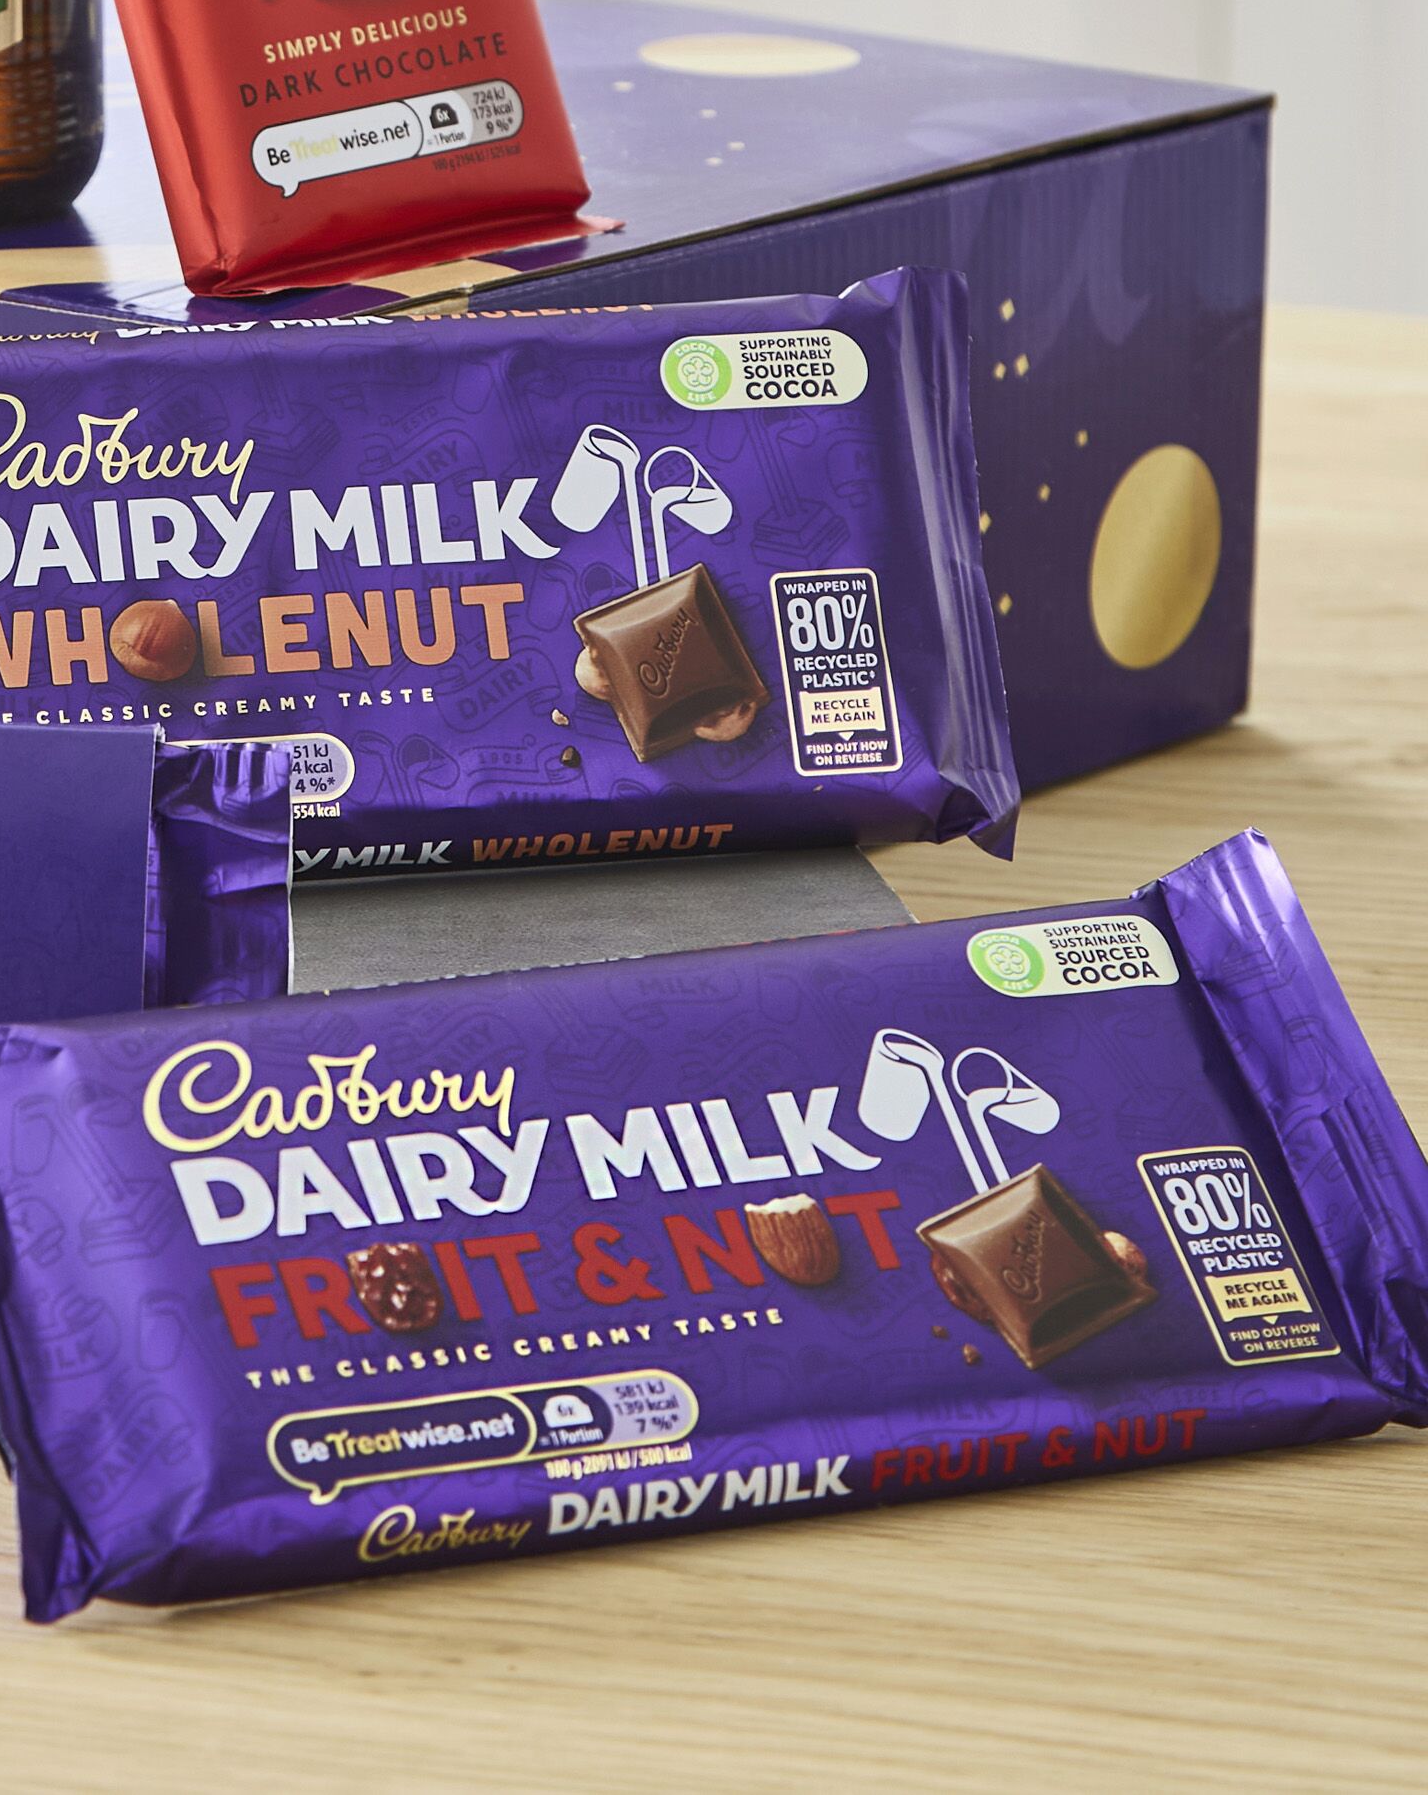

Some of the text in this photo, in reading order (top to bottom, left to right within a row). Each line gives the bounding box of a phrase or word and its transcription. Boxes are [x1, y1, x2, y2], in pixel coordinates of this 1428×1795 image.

[264, 6, 468, 64] SIMPLY DELICIOUS
[239, 32, 508, 108] DARK CHOCOLATE
[493, 100, 514, 115] kcal
[486, 121, 494, 134] 9
[674, 342, 716, 357] COCOA
[739, 337, 831, 350] SUPPORTING
[741, 349, 832, 363] SUSTAINABLY
[744, 363, 835, 379] SOURCED
[746, 379, 838, 400] COCOA
[289, 477, 561, 571] MILK
[784, 579, 867, 595] WRAPPED IN
[787, 593, 874, 652] 80%
[637, 608, 699, 700] Cadbury
[794, 653, 878, 671] RECYCLED
[36, 704, 173, 725] CLASSIC
[193, 695, 317, 716] CREAMY
[338, 687, 434, 707] TASTE
[814, 698, 870, 710] RECYCLE
[812, 711, 876, 724] ME AGAIN
[314, 743, 329, 758] kJ
[806, 740, 888, 754] FIND OUT HOW
[304, 759, 333, 774] kcal
[815, 752, 882, 766] ON REVERSE
[295, 779, 306, 793] 4
[317, 802, 340, 817] kcal
[331, 840, 453, 871] MILK
[471, 823, 734, 864] WHOLENUT
[1044, 922, 1138, 937] SUPPORTING
[1049, 933, 1141, 949] SUSTAINABLY
[1055, 946, 1149, 965] SOURCED
[1062, 961, 1159, 985] COCOA
[142, 1039, 517, 1154] Cadbury
[169, 1086, 882, 1247] DAIRY MILK
[1153, 1158, 1246, 1176] WRAPPED IN
[1164, 1172, 1271, 1235] 80%
[1188, 1233, 1281, 1255] RECYCLED
[574, 1223, 665, 1304] &
[1224, 1279, 1288, 1296] RECYCLE
[1226, 1291, 1299, 1310] ME AGAIN
[1229, 1323, 1321, 1341] FIND OUT HOW
[246, 1308, 785, 1390] THE CLASSIC CREAMY TASTE
[1244, 1336, 1319, 1353] ON REVERSE
[645, 1394, 679, 1411] kcal
[635, 1418, 646, 1433] 7
[560, 1427, 603, 1445] Portion
[664, 1441, 693, 1463] kcal
[358, 1408, 1207, 1563] Cadbury DAIRY MILK FRUIT & NUT
